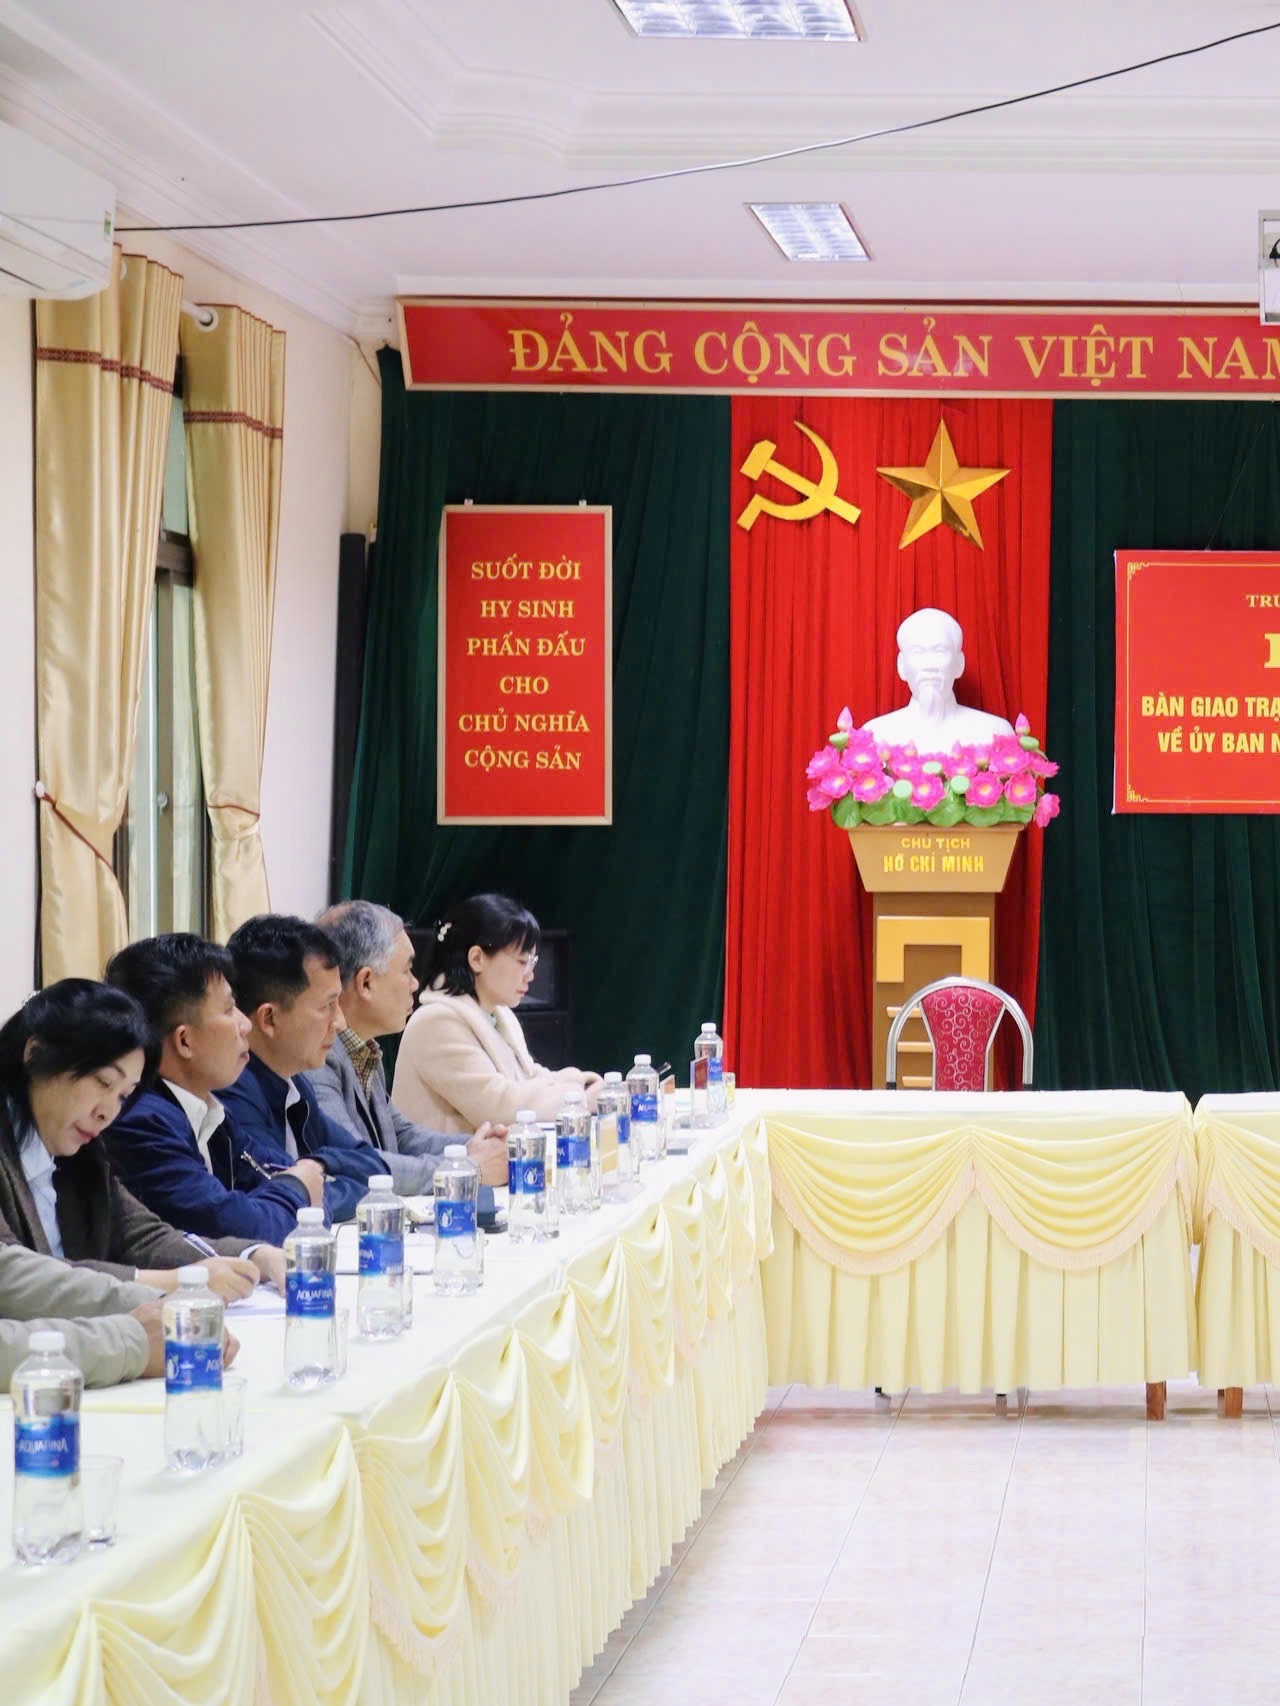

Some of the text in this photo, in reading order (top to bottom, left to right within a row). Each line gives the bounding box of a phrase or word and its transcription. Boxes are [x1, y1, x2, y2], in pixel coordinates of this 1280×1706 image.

[508, 312, 673, 374] ĐẢNG
[693, 320, 857, 384] CỘNG
[877, 317, 992, 378] SẢN
[1015, 323, 1154, 386] VIỆT
[471, 553, 582, 581] SUỐT ĐỜI
[481, 600, 574, 619] HY SINH
[466, 630, 586, 657] PHẤN ĐẤU
[499, 676, 550, 695] CHO
[1141, 692, 1185, 718] BÀN
[1191, 696, 1239, 718] GIAO
[458, 707, 591, 733] CHỦ NGHĨA
[1157, 726, 1183, 753] VỀ
[1189, 726, 1216, 753] ỦY
[1222, 732, 1265, 754] BAN
[464, 744, 582, 772] CỘNG SẢN
[941, 855, 985, 873] MINH
